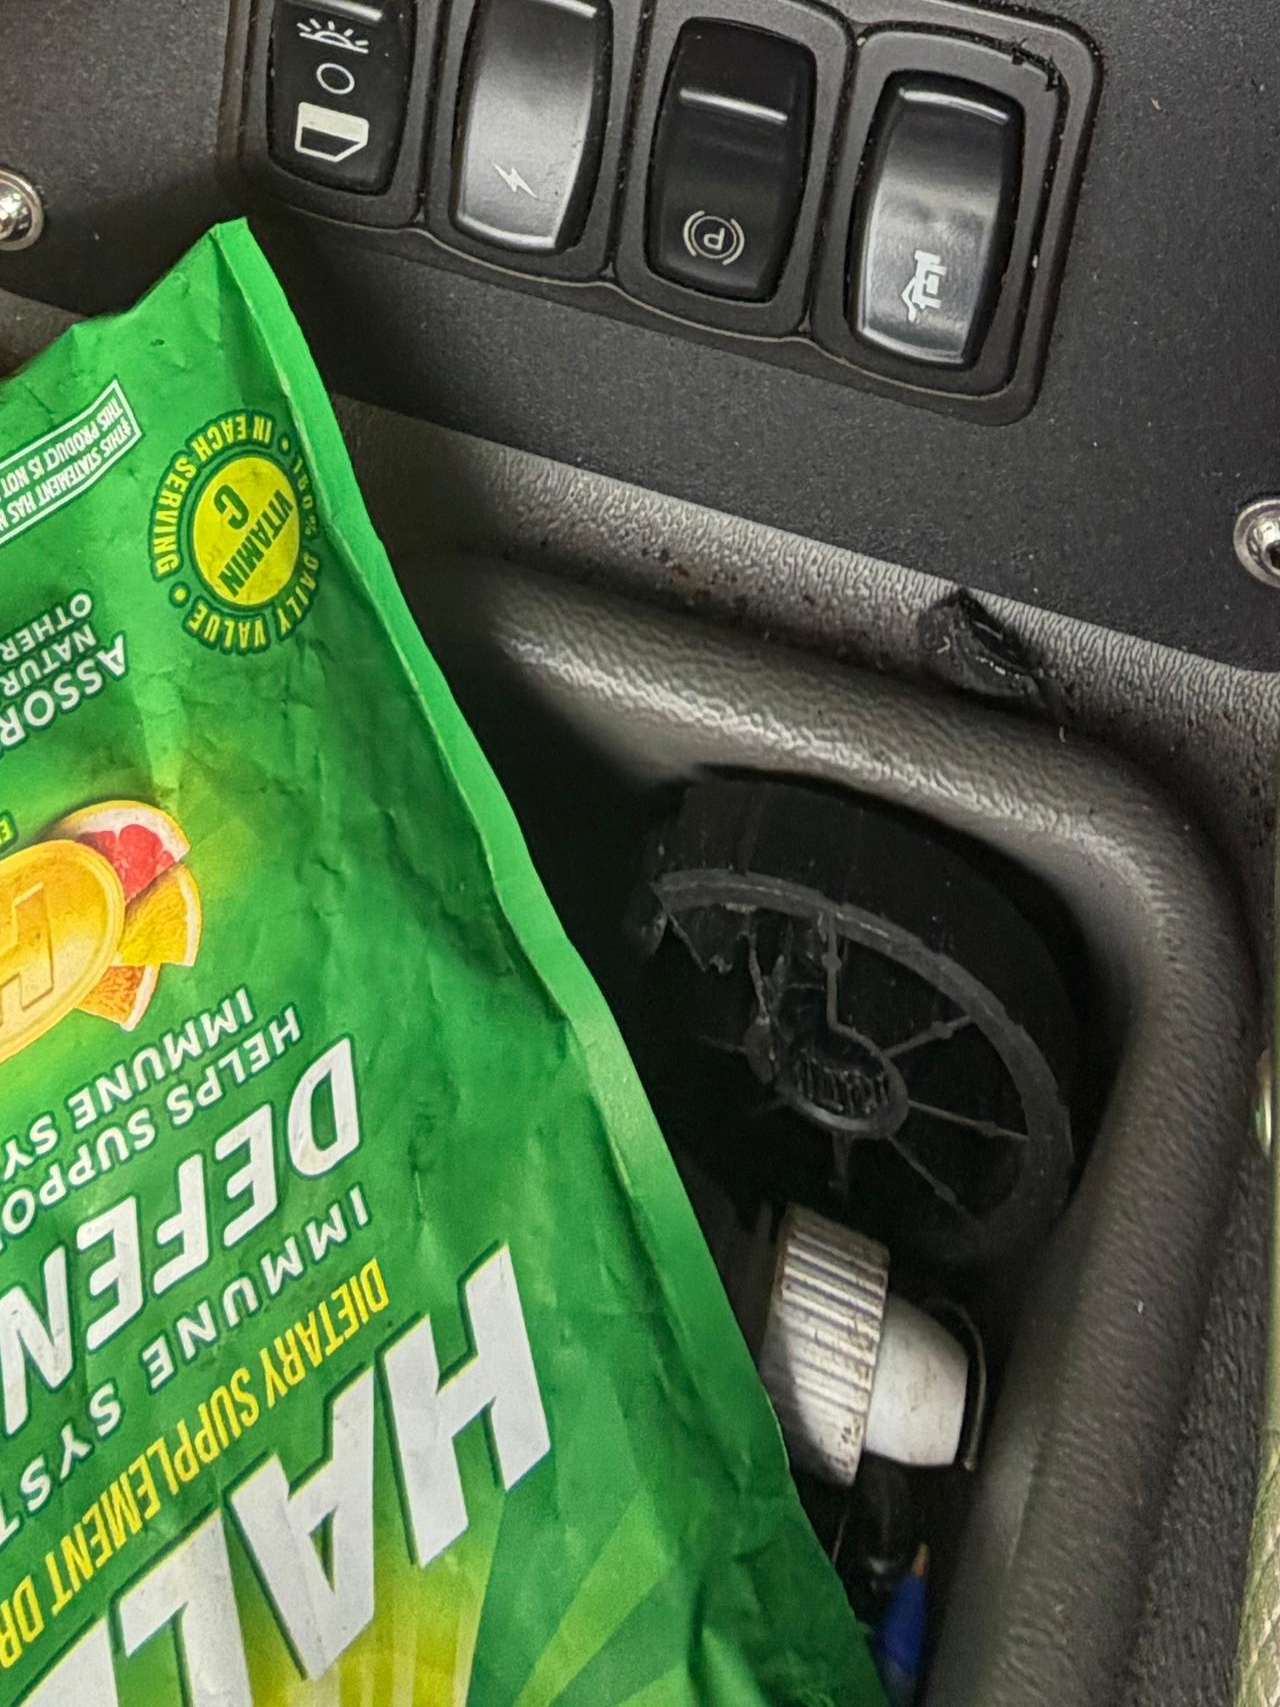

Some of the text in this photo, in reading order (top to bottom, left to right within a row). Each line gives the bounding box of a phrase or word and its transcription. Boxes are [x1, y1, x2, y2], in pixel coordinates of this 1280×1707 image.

[43, 421, 101, 471] PRODUCT
[96, 397, 124, 431] THIS
[0, 466, 29, 498] NOT
[27, 456, 45, 480] IS
[35, 447, 102, 506] STATEMENT
[153, 413, 273, 578] IN EACH SERVING
[7, 491, 37, 524] HAS
[212, 483, 250, 531] C
[216, 488, 294, 599] VITAMIN
[187, 600, 267, 649] VALUE
[274, 551, 320, 636] DAILY
[68, 989, 253, 1129] IMMUNE
[166, 1007, 300, 1125] HELPS
[142, 1187, 369, 1389] IMMUNE
[259, 1258, 389, 1408] DIETARY
[45, 1367, 260, 1609] SUPPLEMENT
